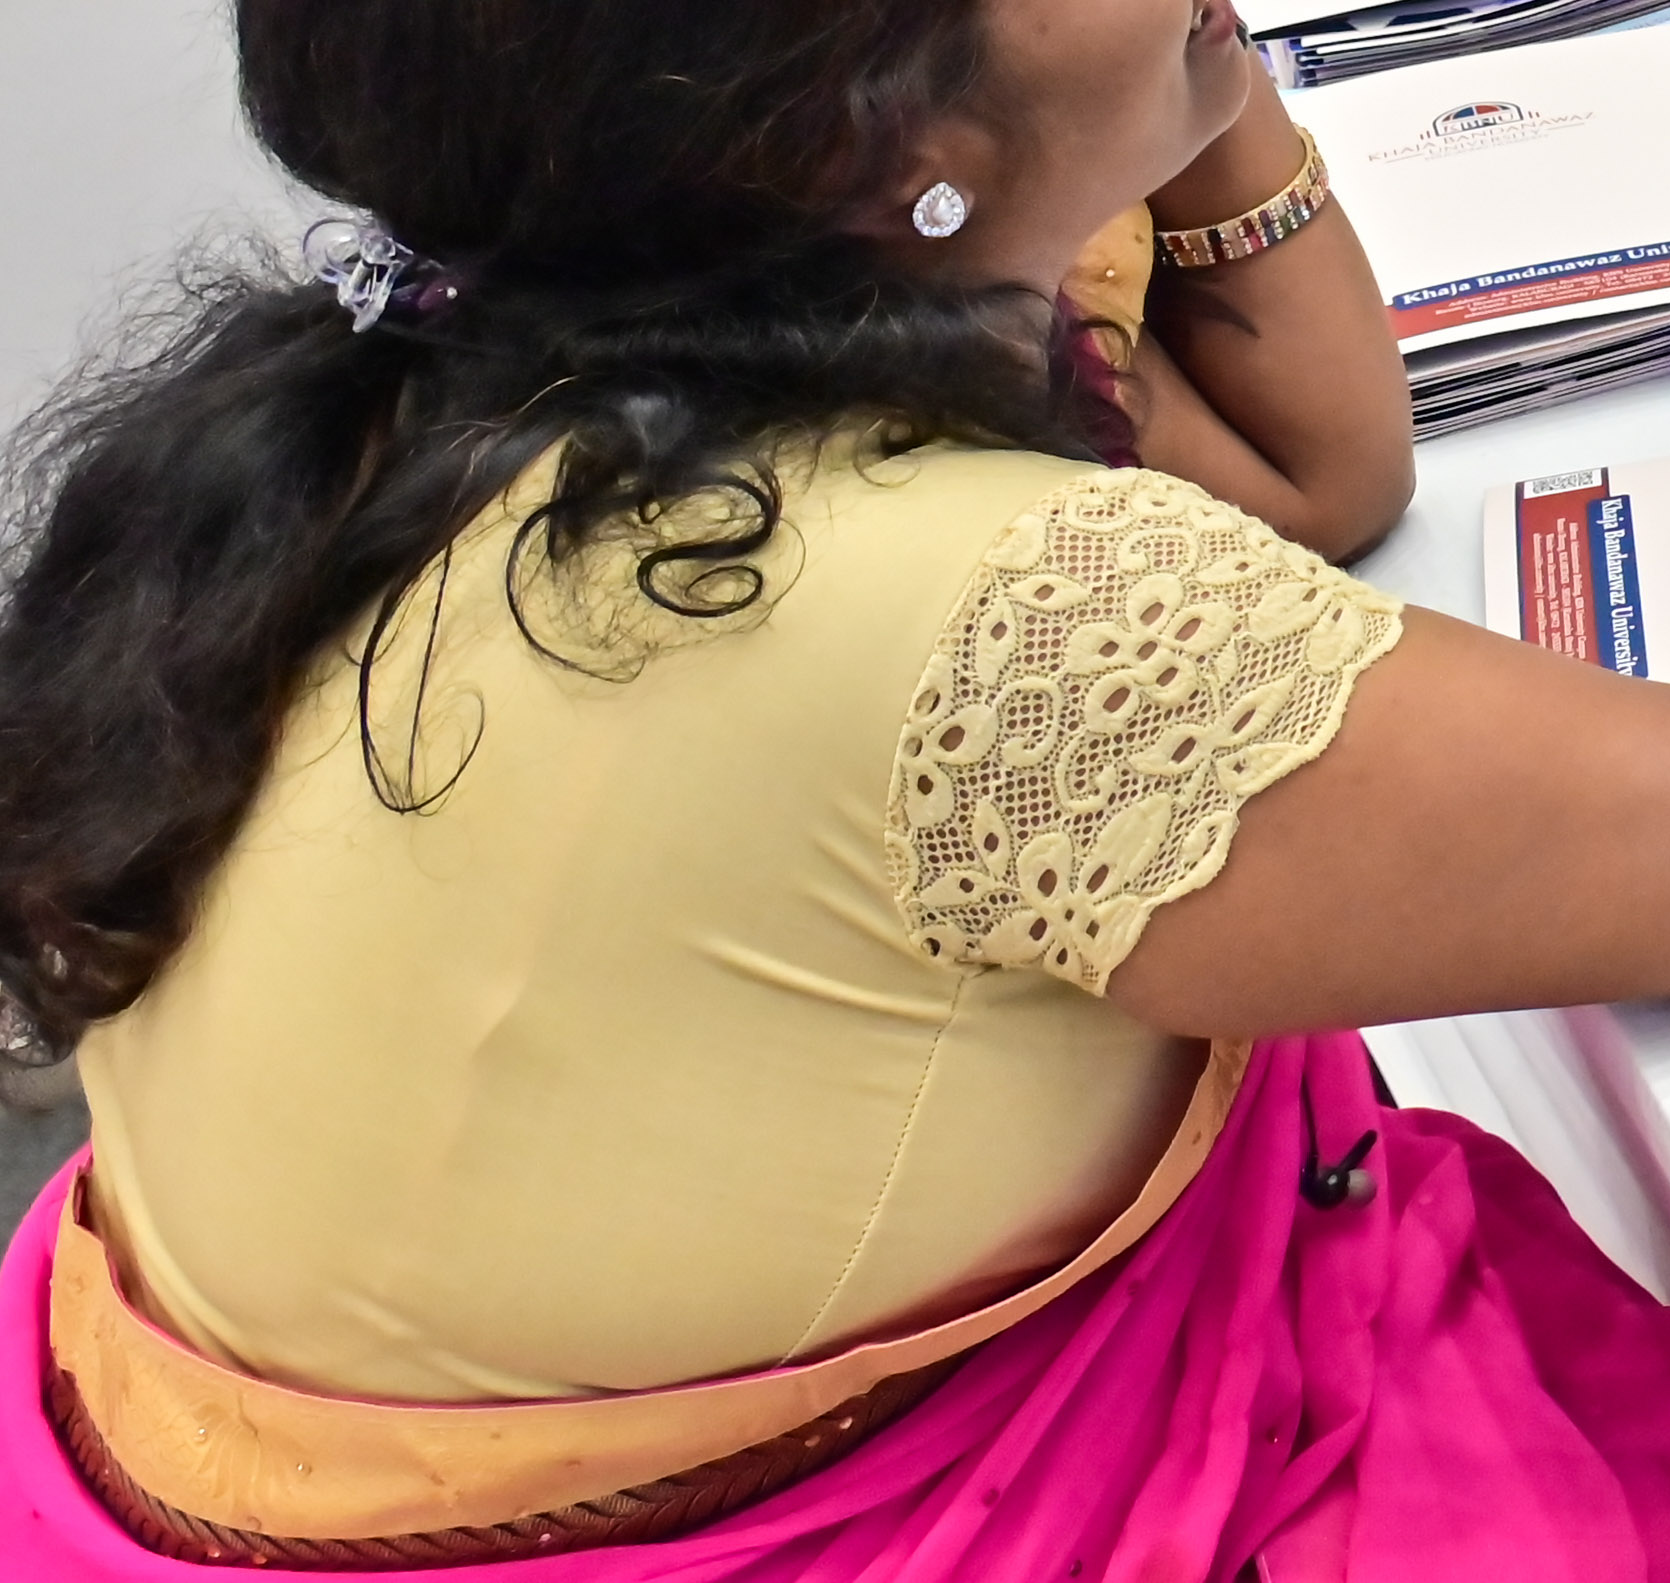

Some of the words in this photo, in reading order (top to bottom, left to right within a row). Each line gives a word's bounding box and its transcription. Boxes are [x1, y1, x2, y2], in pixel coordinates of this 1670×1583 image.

[1403, 281, 1472, 307] Khaja
[1476, 252, 1624, 289] Bandanawaz
[1596, 498, 1622, 530] Khaja
[1604, 530, 1629, 607] Bandanawaz
